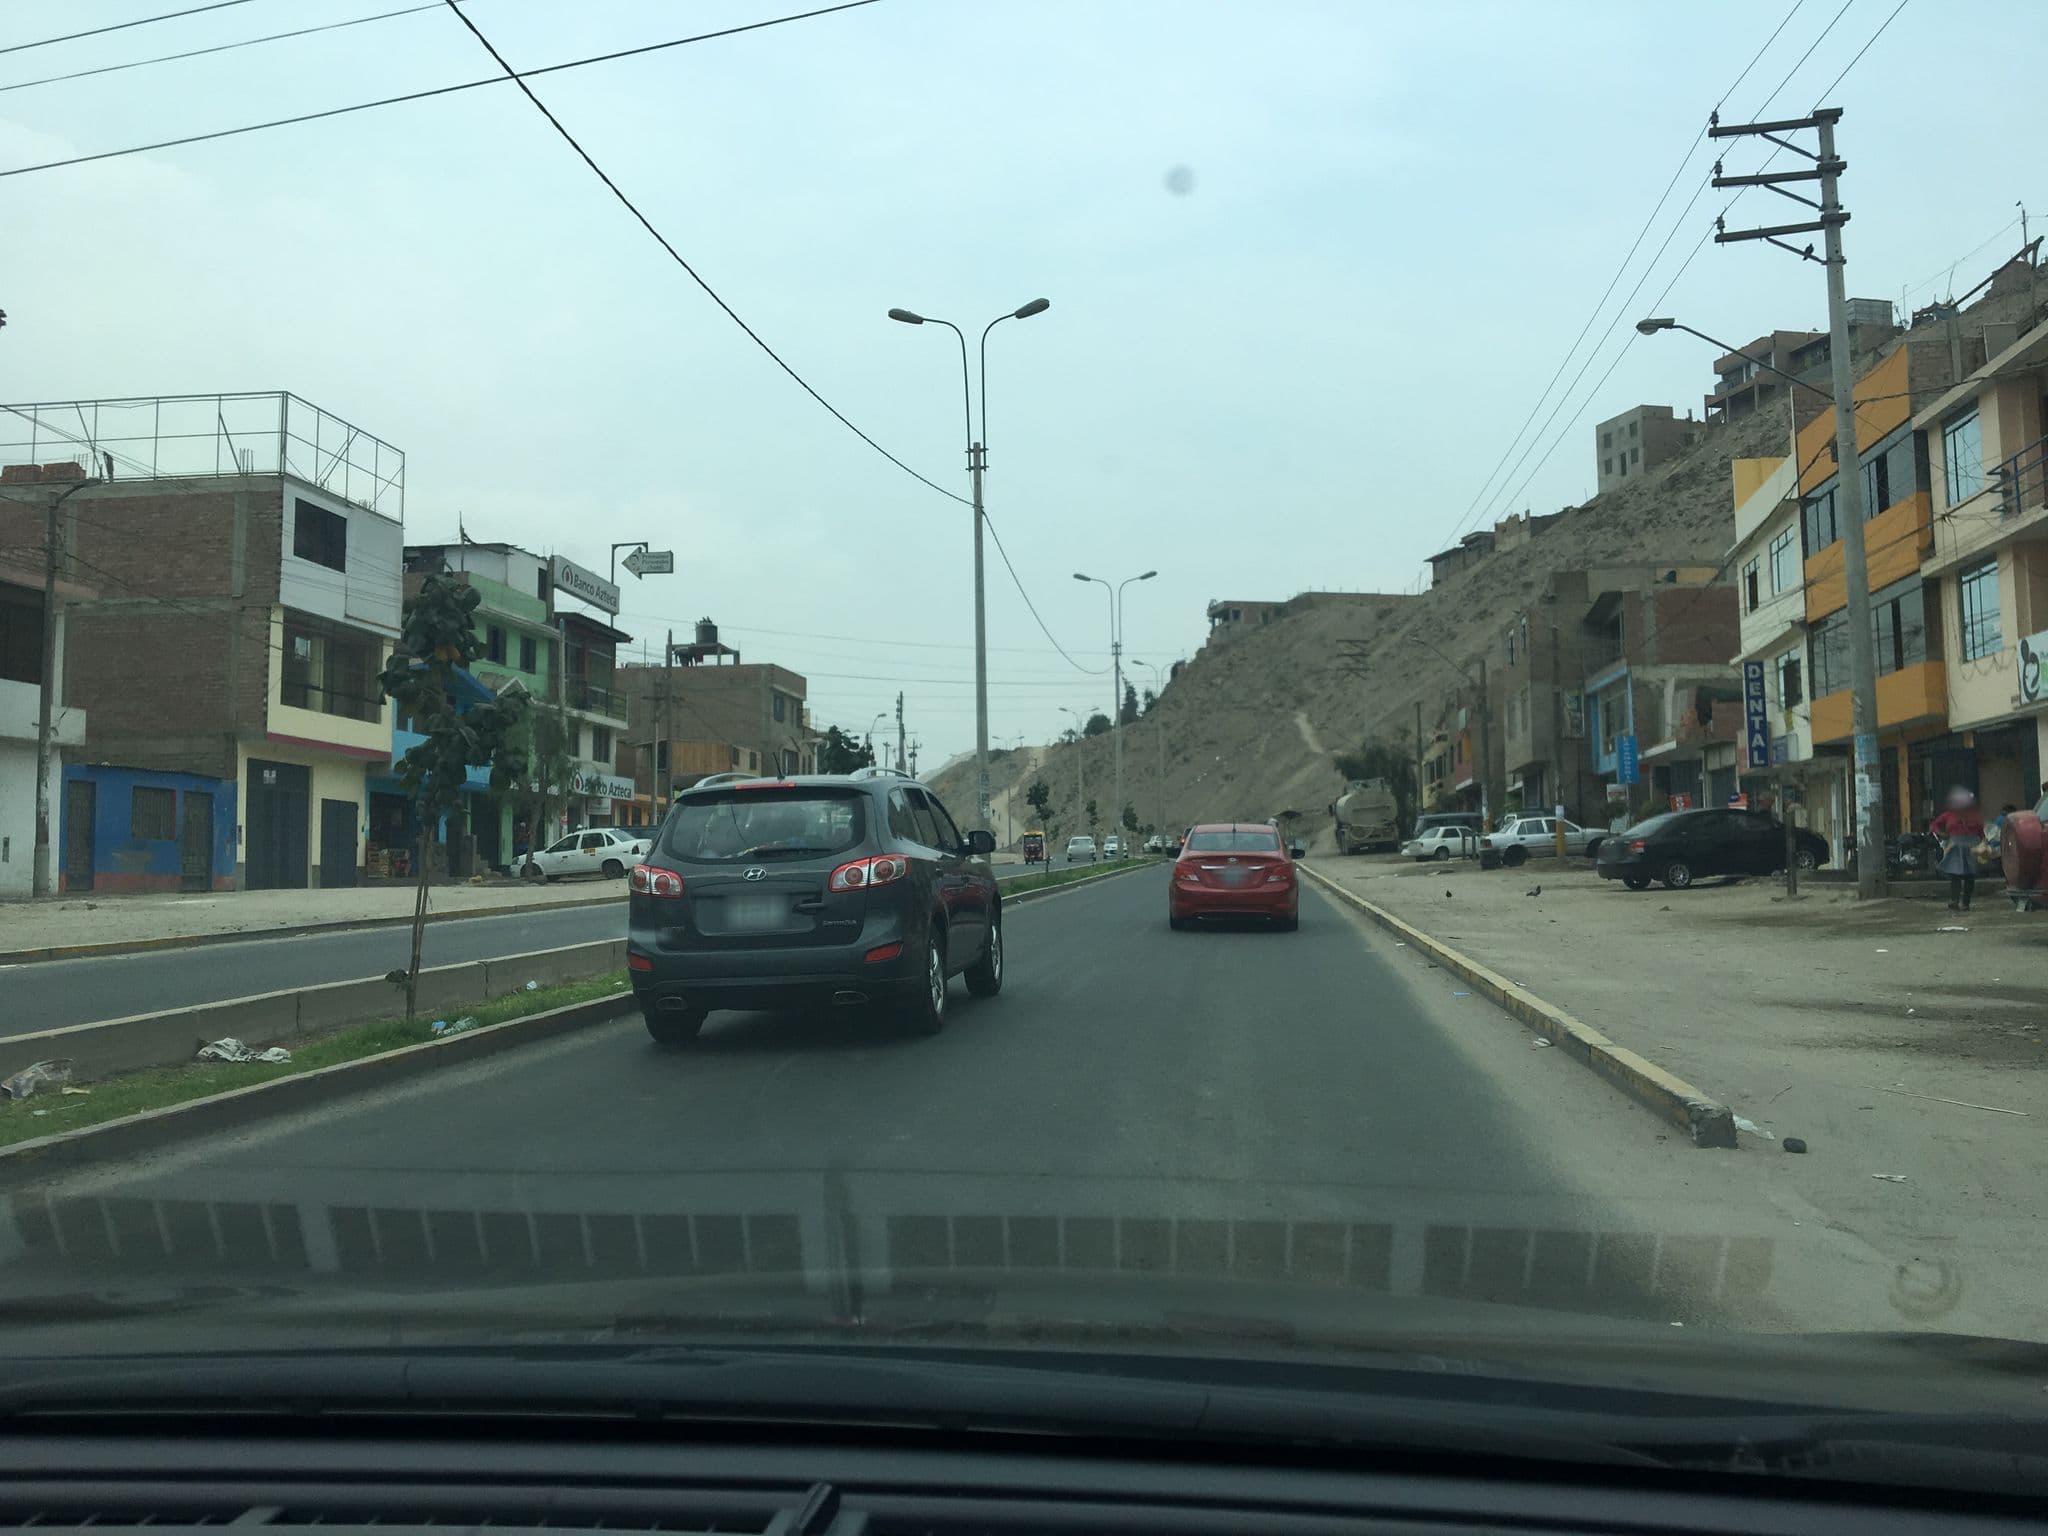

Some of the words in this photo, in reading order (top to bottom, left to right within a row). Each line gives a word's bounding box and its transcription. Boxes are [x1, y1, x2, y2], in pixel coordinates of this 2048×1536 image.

[574, 574, 595, 596] Banco
[595, 586, 617, 607] Azteca
[1747, 664, 1766, 765] DENTAL
[608, 782, 632, 799] Azteca
